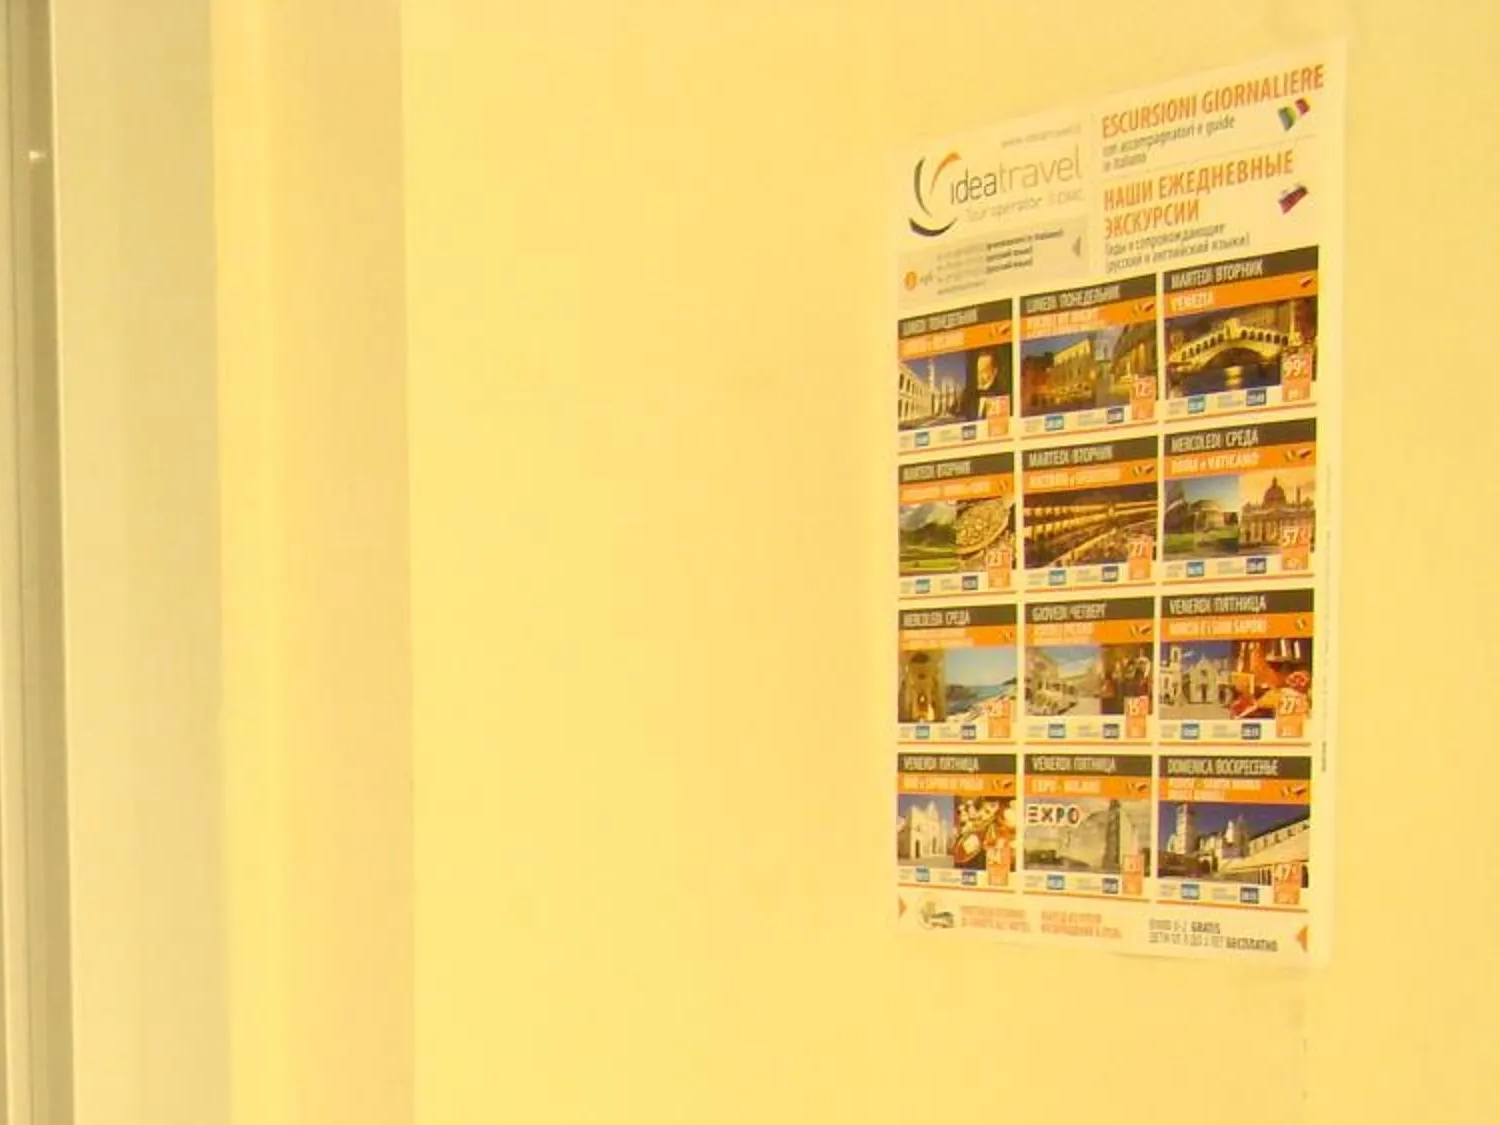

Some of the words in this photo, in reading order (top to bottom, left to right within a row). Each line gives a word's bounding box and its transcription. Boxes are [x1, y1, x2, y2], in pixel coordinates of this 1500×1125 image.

[1102, 94, 1198, 139] ESCURSIONI
[1201, 64, 1324, 114] GIORNALIERE
[1205, 114, 1235, 137] guide
[950, 143, 1082, 205] ideatravel
[1103, 180, 1153, 212] НАШИ
[1158, 149, 1294, 200] ЕЖЕДНЕВНЫЕ
[1104, 199, 1200, 240] ЭКСКУРСИИ
[1215, 259, 1264, 282] ВТОРНИК
[1225, 428, 1259, 447] СРЕДА
[1215, 594, 1268, 614] ПЯТНИЦА
[1167, 758, 1213, 775] DOMENICA
[1027, 806, 1080, 825] EXPO
